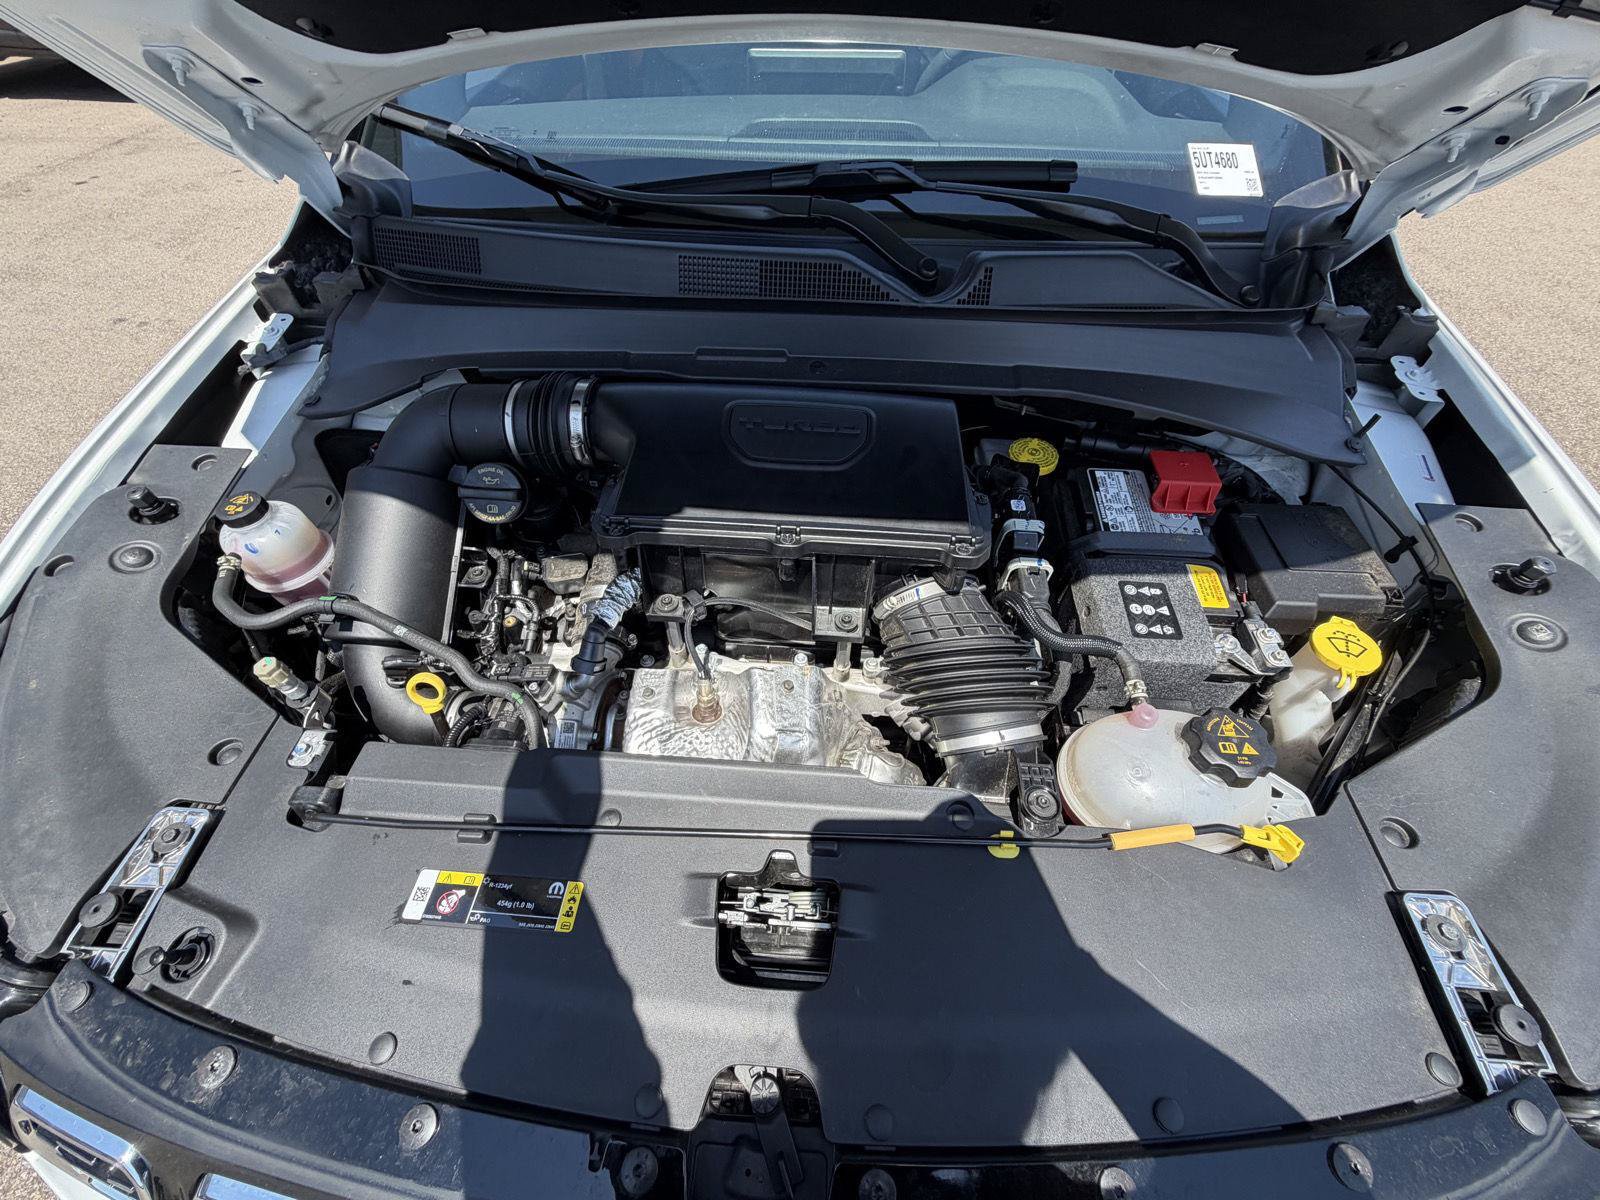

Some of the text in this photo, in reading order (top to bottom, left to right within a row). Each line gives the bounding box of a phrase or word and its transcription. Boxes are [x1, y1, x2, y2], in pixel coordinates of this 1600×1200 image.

[1193, 151, 1238, 168] 5UT4680
[497, 899, 534, 910] 454g (1.0 lb)
